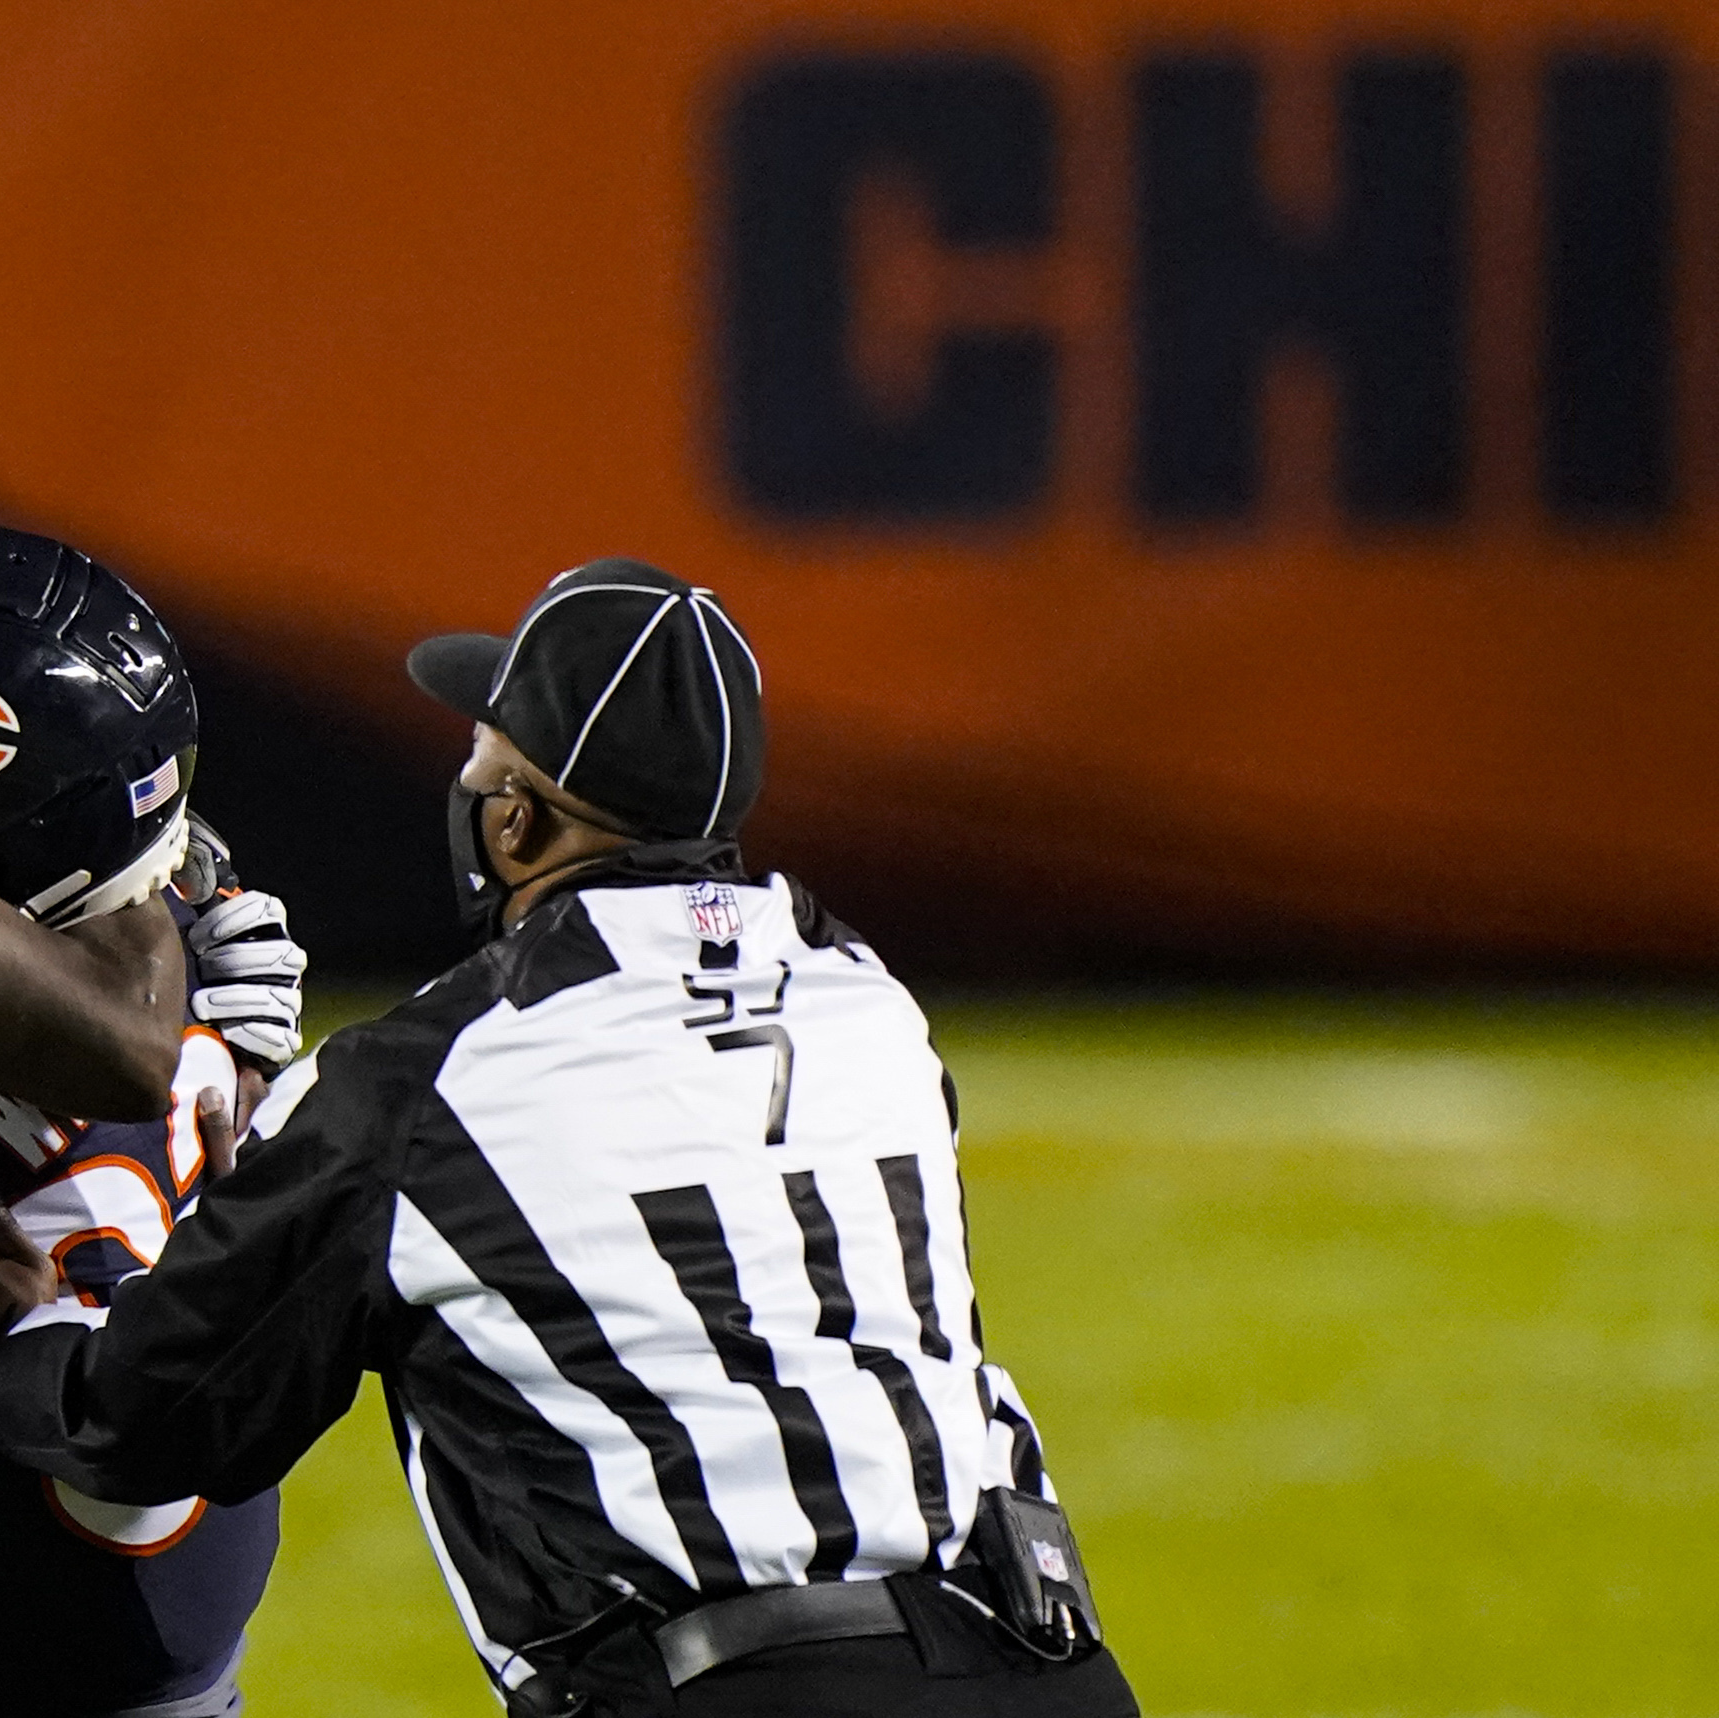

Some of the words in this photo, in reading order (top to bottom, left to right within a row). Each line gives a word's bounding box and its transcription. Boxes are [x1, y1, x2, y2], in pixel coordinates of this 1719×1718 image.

[715, 50, 1675, 528] CHI
[690, 905, 739, 935] NFL
[705, 1024, 795, 1147] 7
